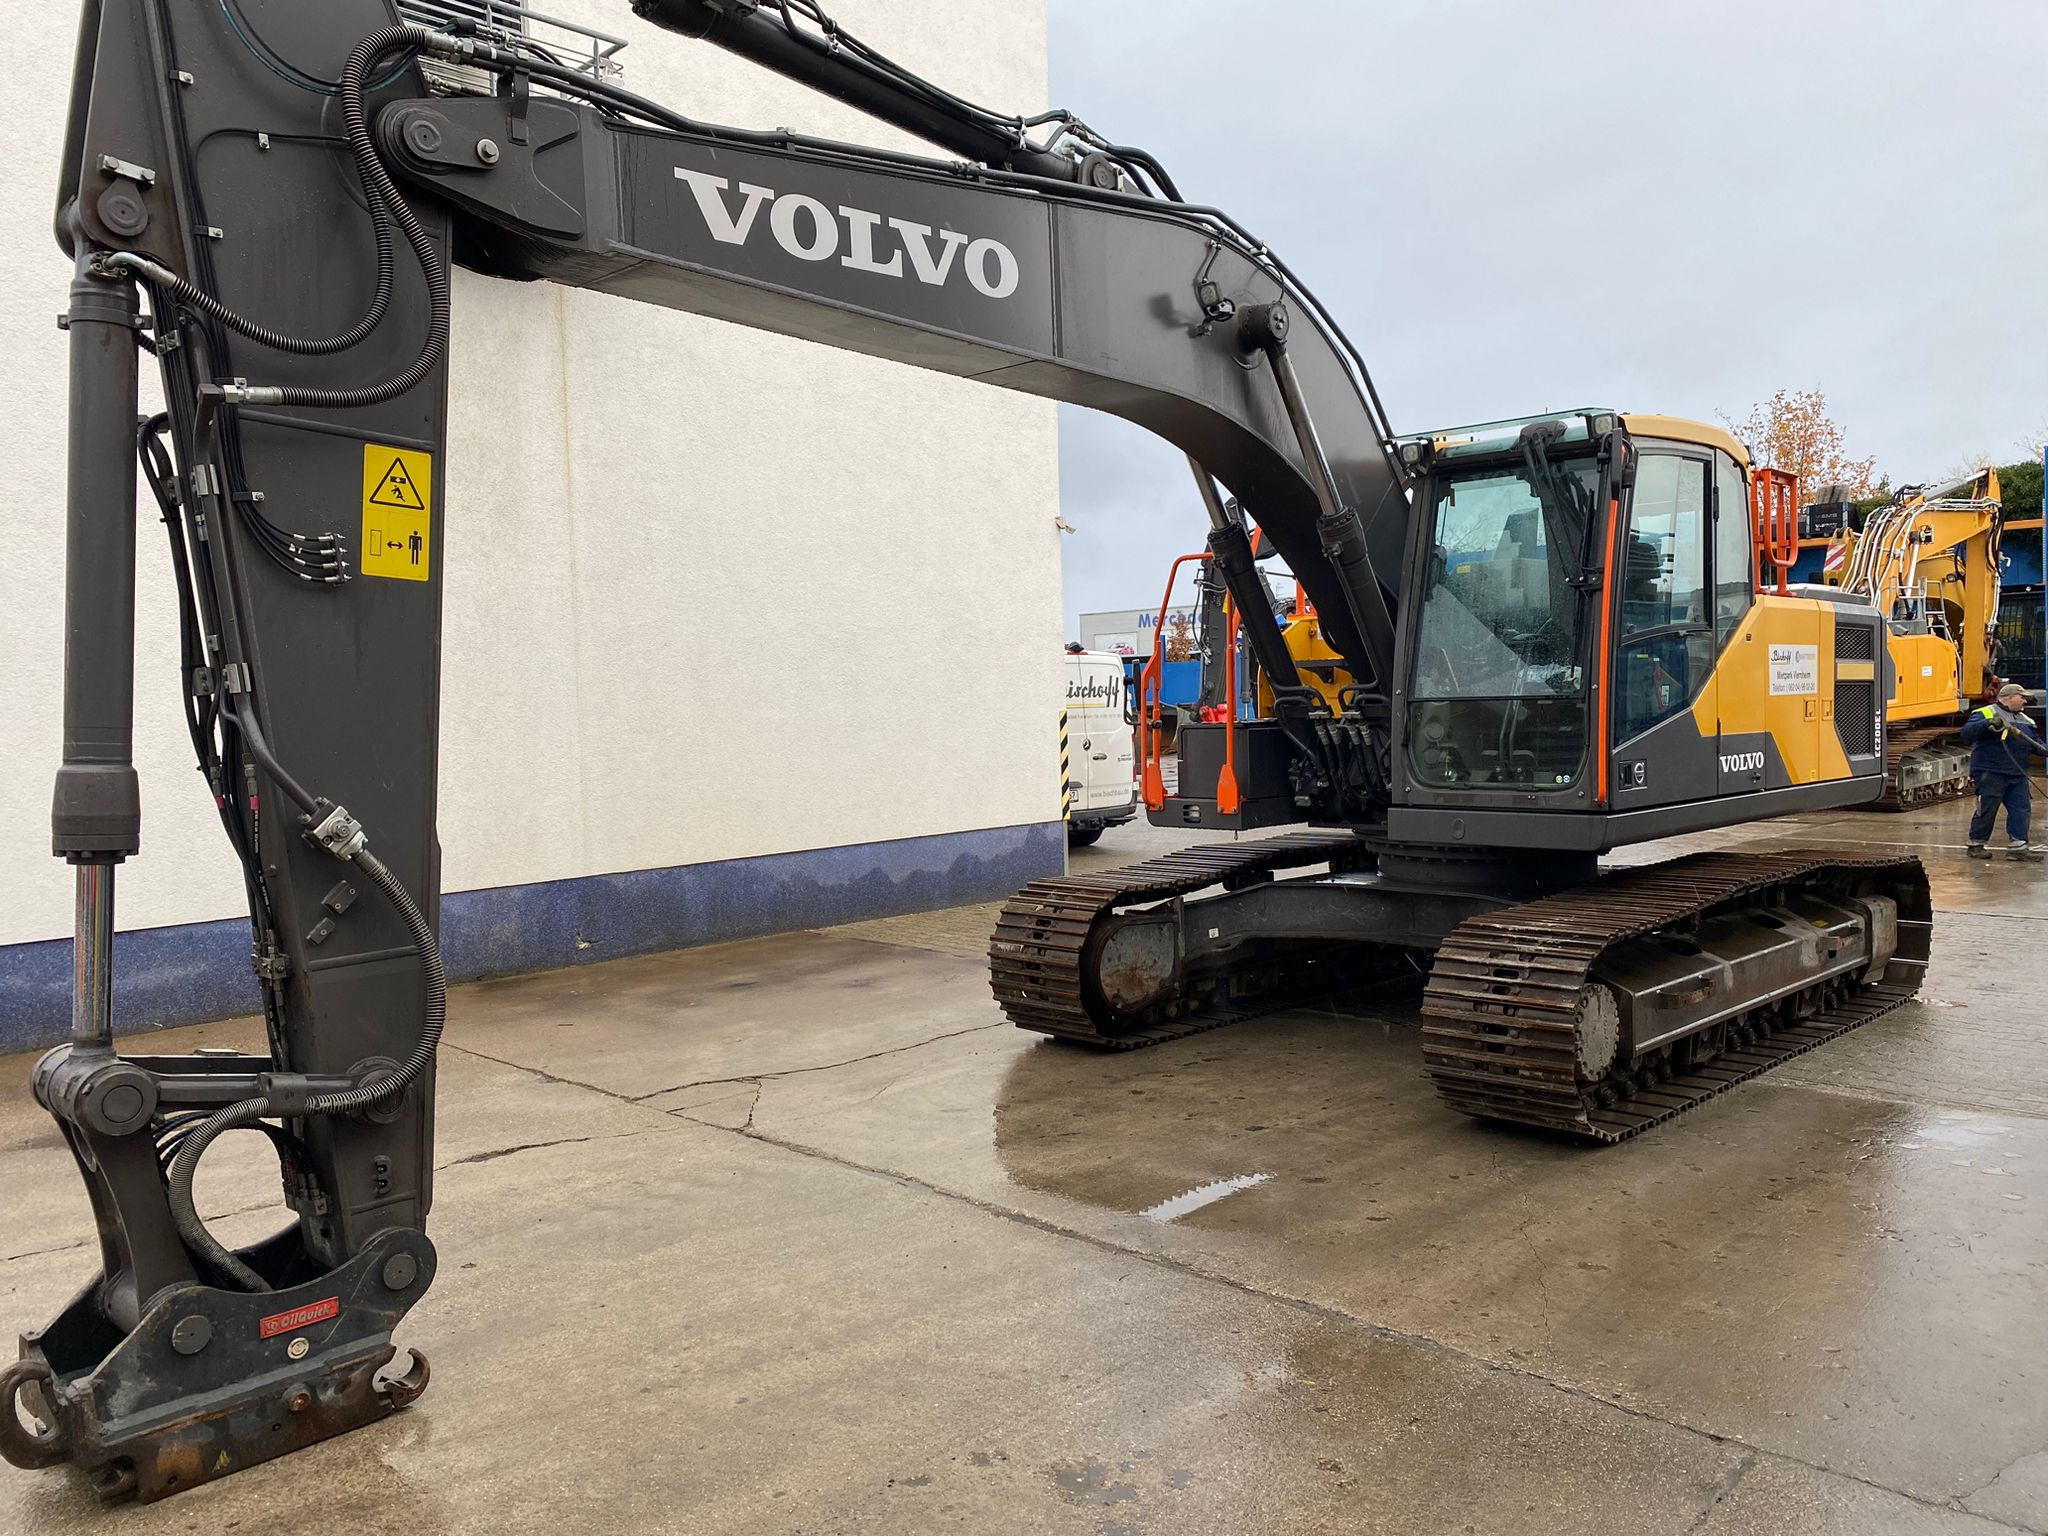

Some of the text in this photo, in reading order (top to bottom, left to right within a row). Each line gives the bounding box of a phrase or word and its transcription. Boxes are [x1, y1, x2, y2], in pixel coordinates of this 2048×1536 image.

[674, 167, 1019, 299] VOLVO
[1065, 675, 1119, 708] ischoff
[1720, 751, 1765, 773] VOLVO
